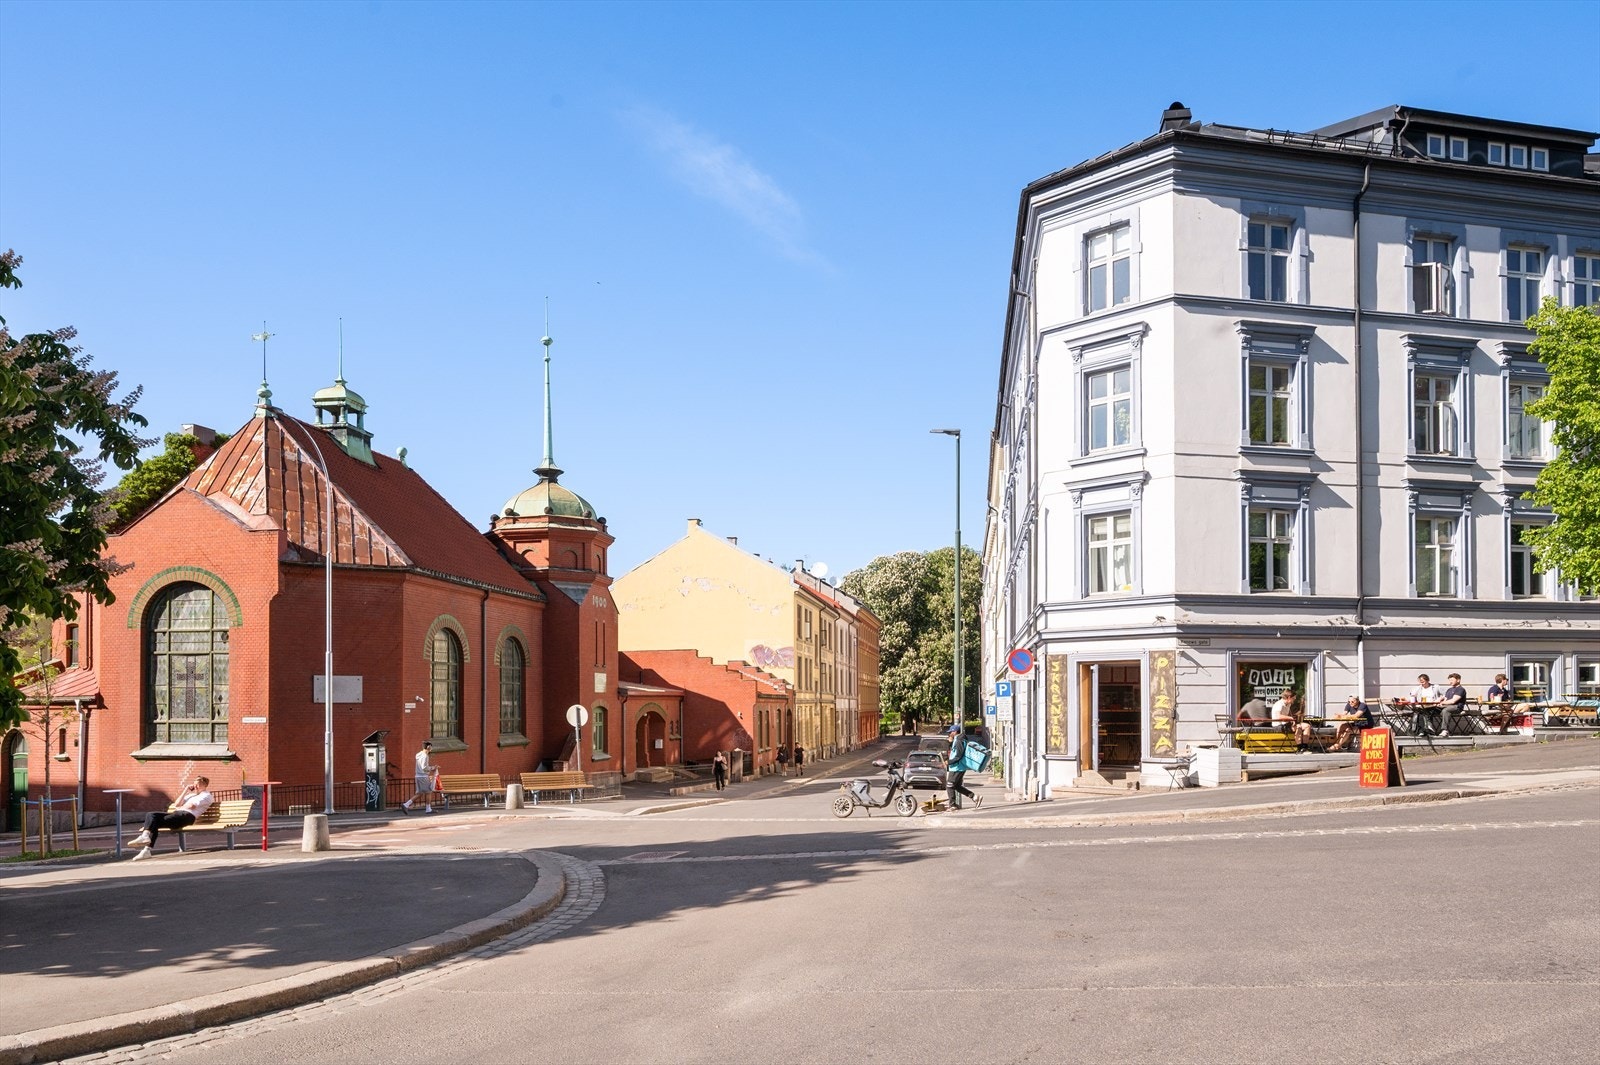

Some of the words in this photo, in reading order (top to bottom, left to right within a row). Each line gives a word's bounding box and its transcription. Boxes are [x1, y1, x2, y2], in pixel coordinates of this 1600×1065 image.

[592, 595, 607, 608] 1900
[1250, 670, 1294, 683] QUIZ
[999, 684, 1008, 695] P
[1050, 661, 1061, 747] SKRENTEN
[1153, 657, 1173, 750] PIZZA
[1362, 732, 1387, 749] ÅPENT
[1363, 772, 1384, 783] PIZZA
